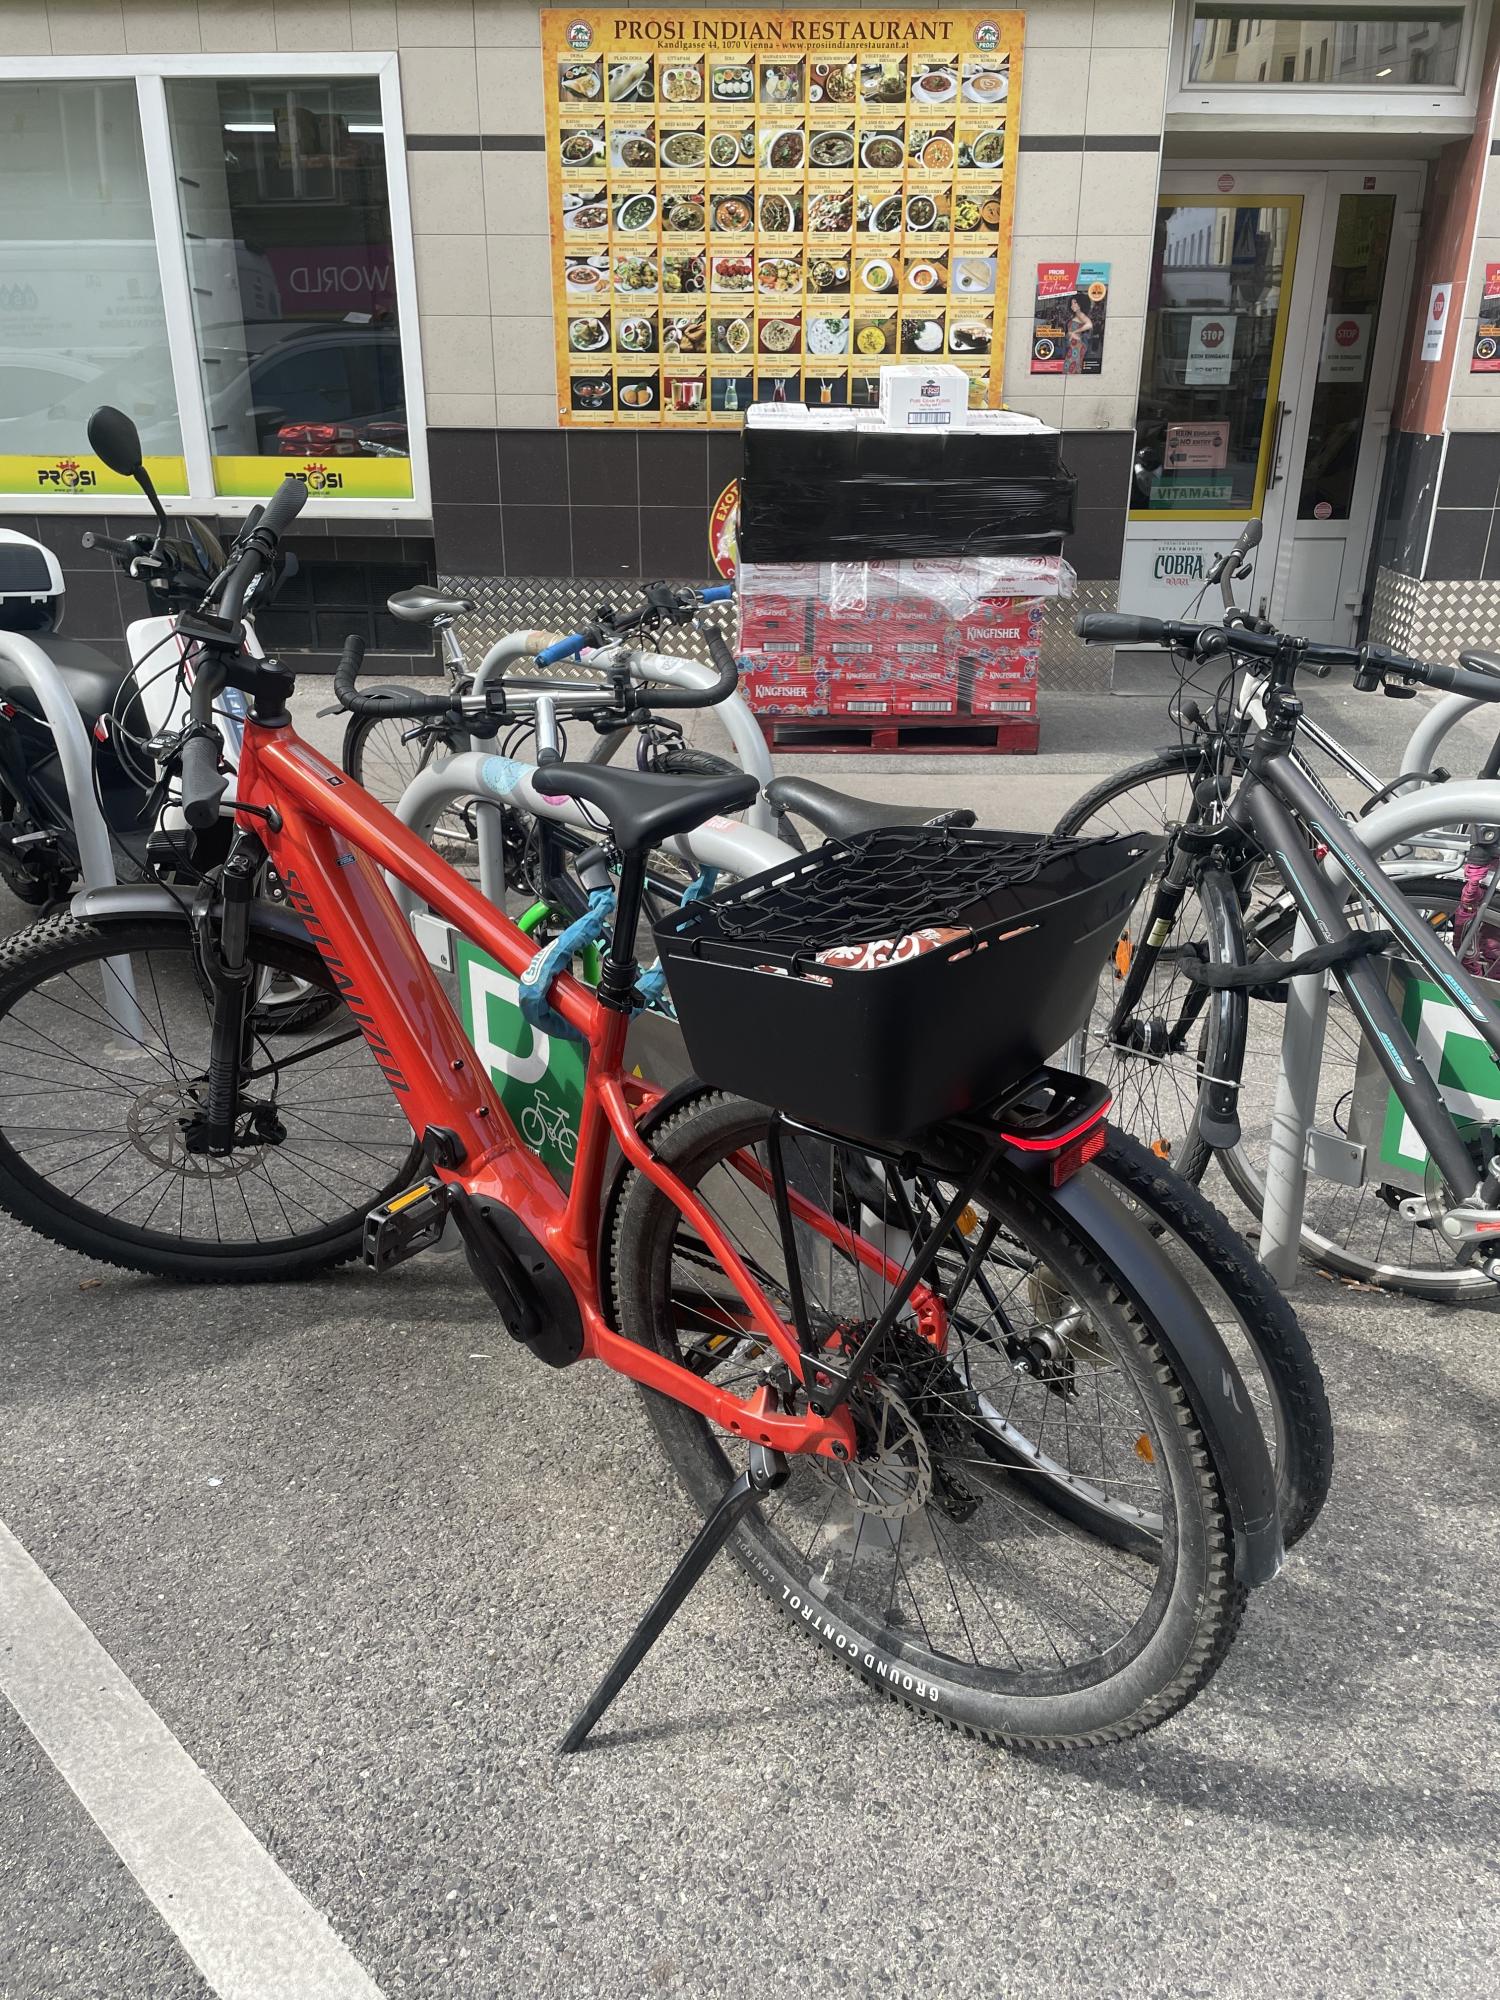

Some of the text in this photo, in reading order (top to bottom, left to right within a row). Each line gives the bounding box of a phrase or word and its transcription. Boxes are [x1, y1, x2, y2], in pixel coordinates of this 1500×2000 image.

[614, 20, 684, 40] PROSI
[692, 20, 783, 40] INDIAN
[792, 21, 953, 40] RESTAURANT
[657, 40, 705, 50] Kandlgasse
[722, 41, 741, 49] 1070
[744, 41, 774, 49] Vienna
[782, 41, 909, 50] www.prosiindianrestaurant.at
[1202, 331, 1224, 340] STOP
[1337, 329, 1358, 338] STOP
[37, 468, 96, 487] PROSI
[1158, 487, 1226, 499] VITAMALT
[1154, 555, 1203, 580] COBRA
[966, 626, 1021, 641] KINGFISHER
[755, 685, 808, 698] KINGFISHER
[736, 1537, 775, 1583] CONTROL
[782, 1584, 859, 1657] CONTROL
[863, 1653, 939, 1702] GROUND
